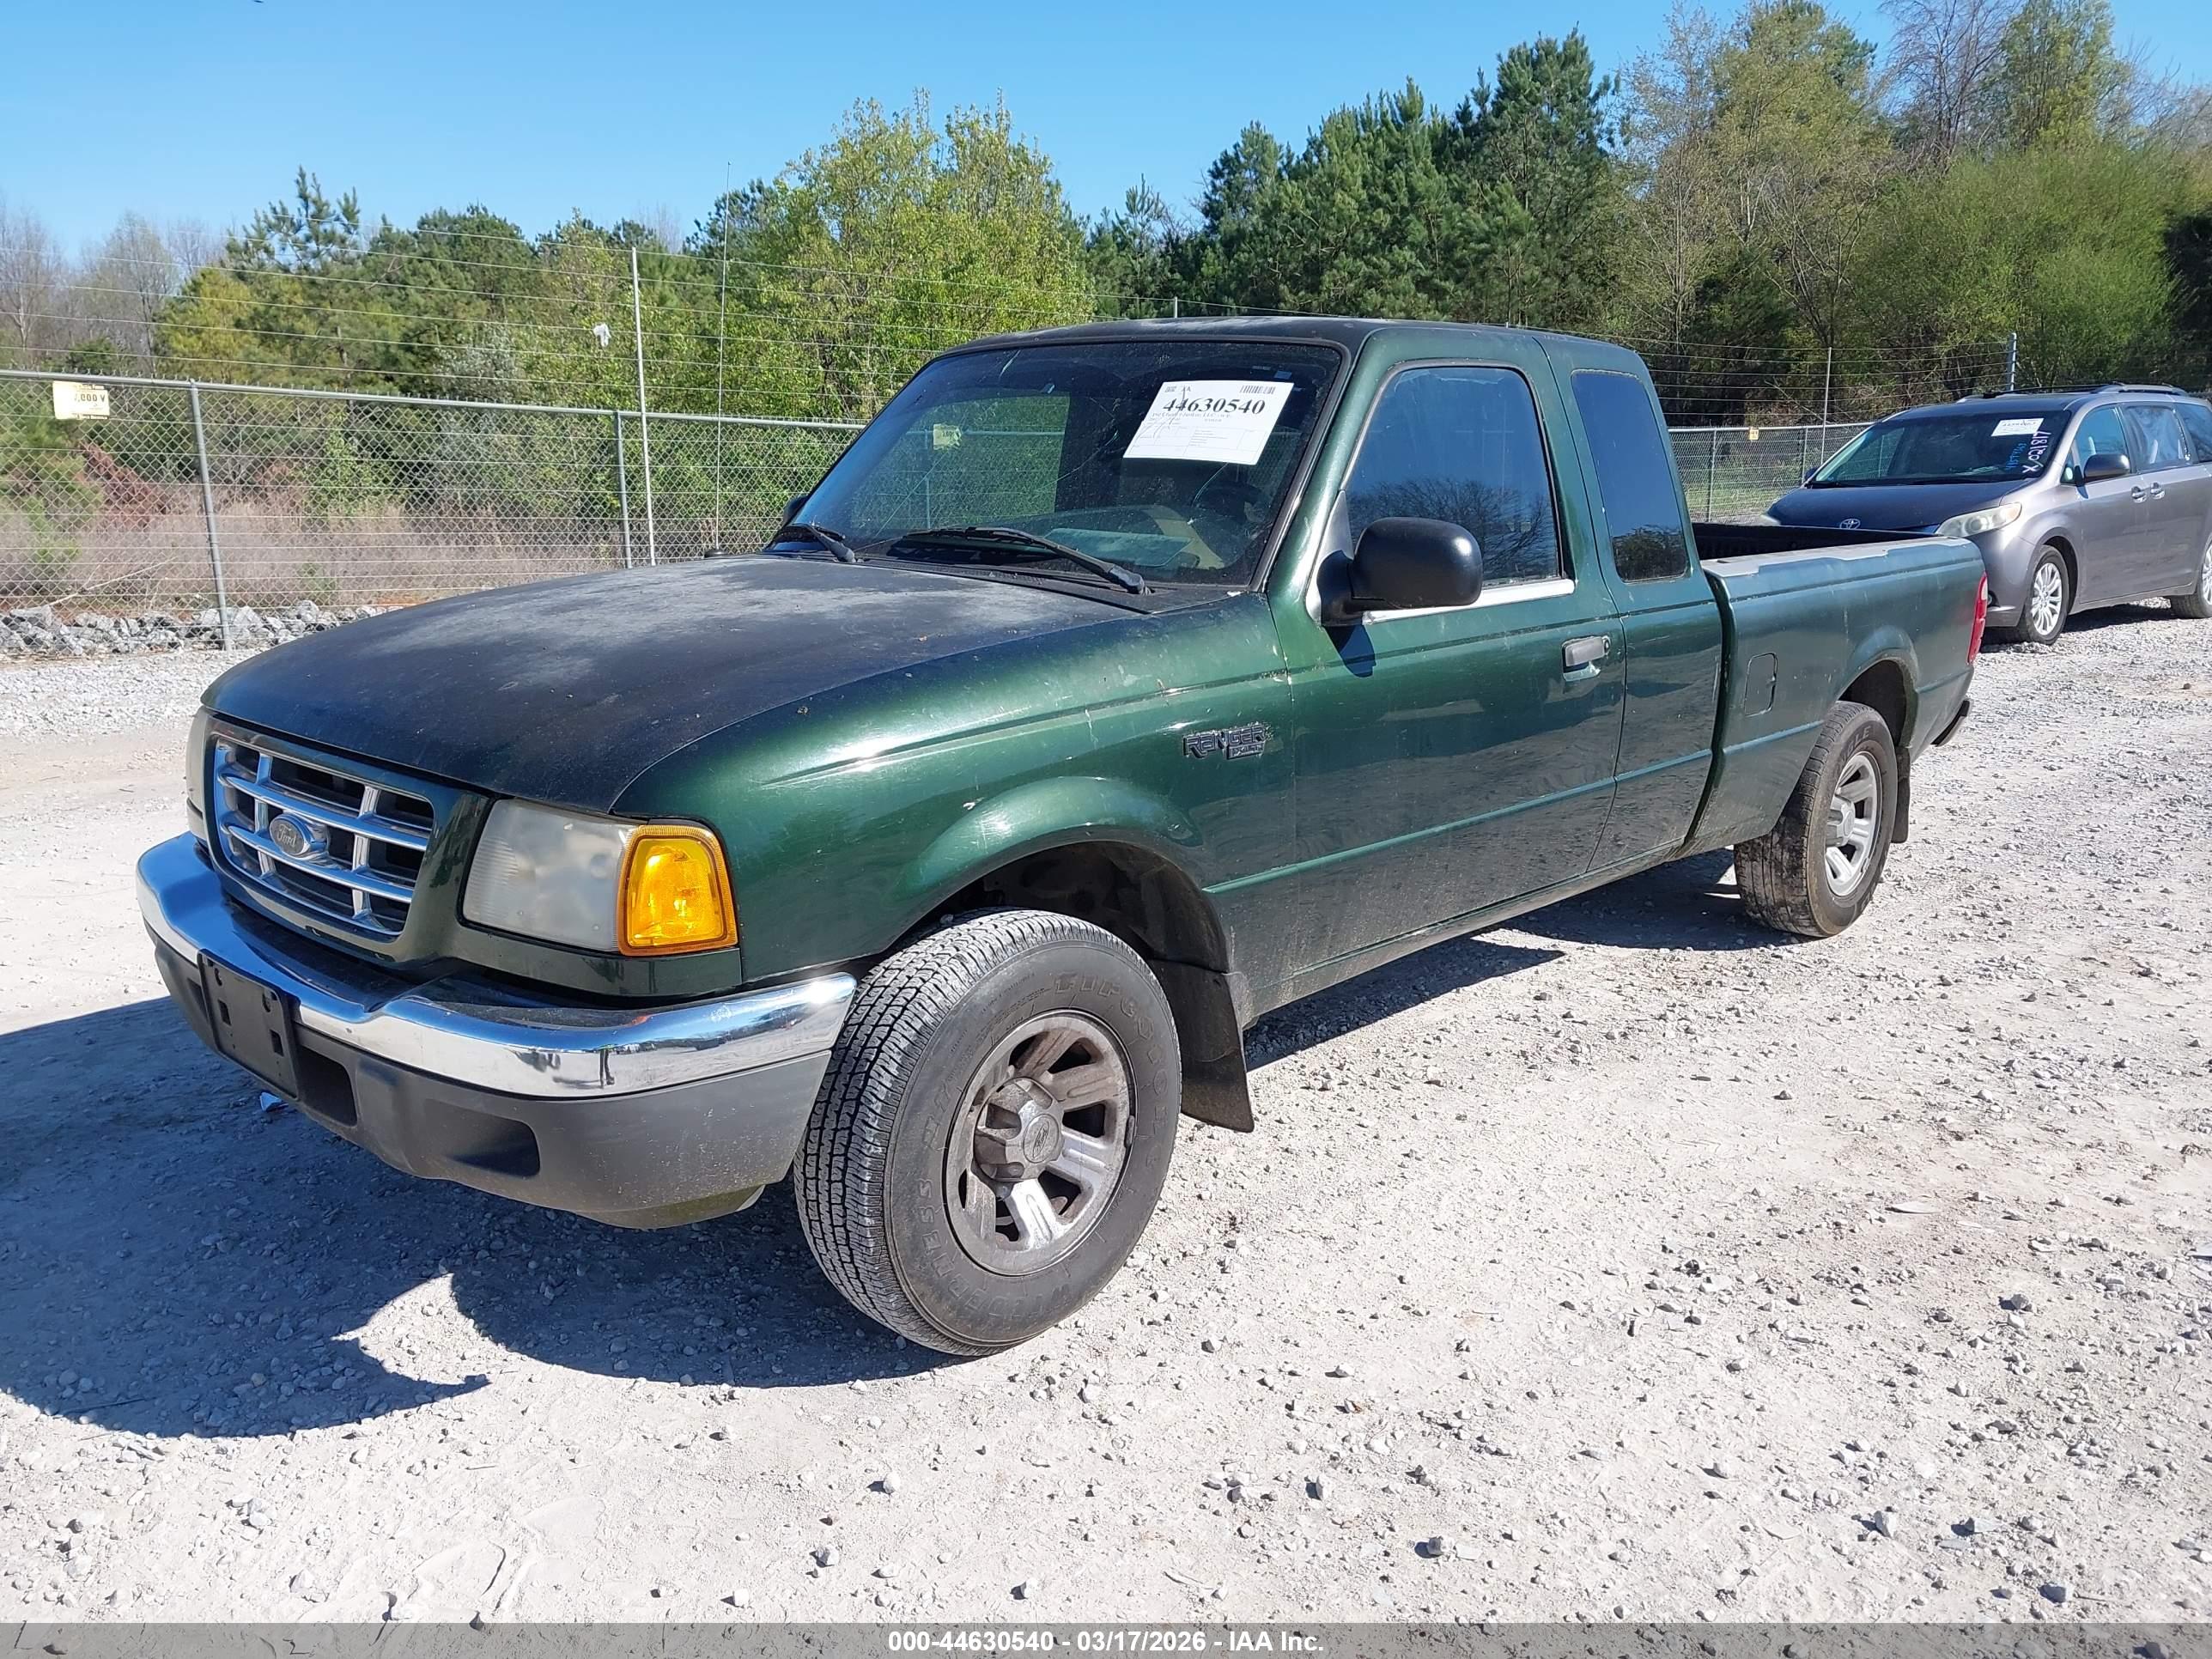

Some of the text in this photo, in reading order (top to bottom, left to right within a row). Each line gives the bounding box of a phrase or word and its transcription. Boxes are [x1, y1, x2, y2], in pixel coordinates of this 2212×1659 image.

[1163, 398, 1266, 415] 44630540
[1183, 723, 1265, 758] RANGER
[277, 823, 297, 848] Ford
